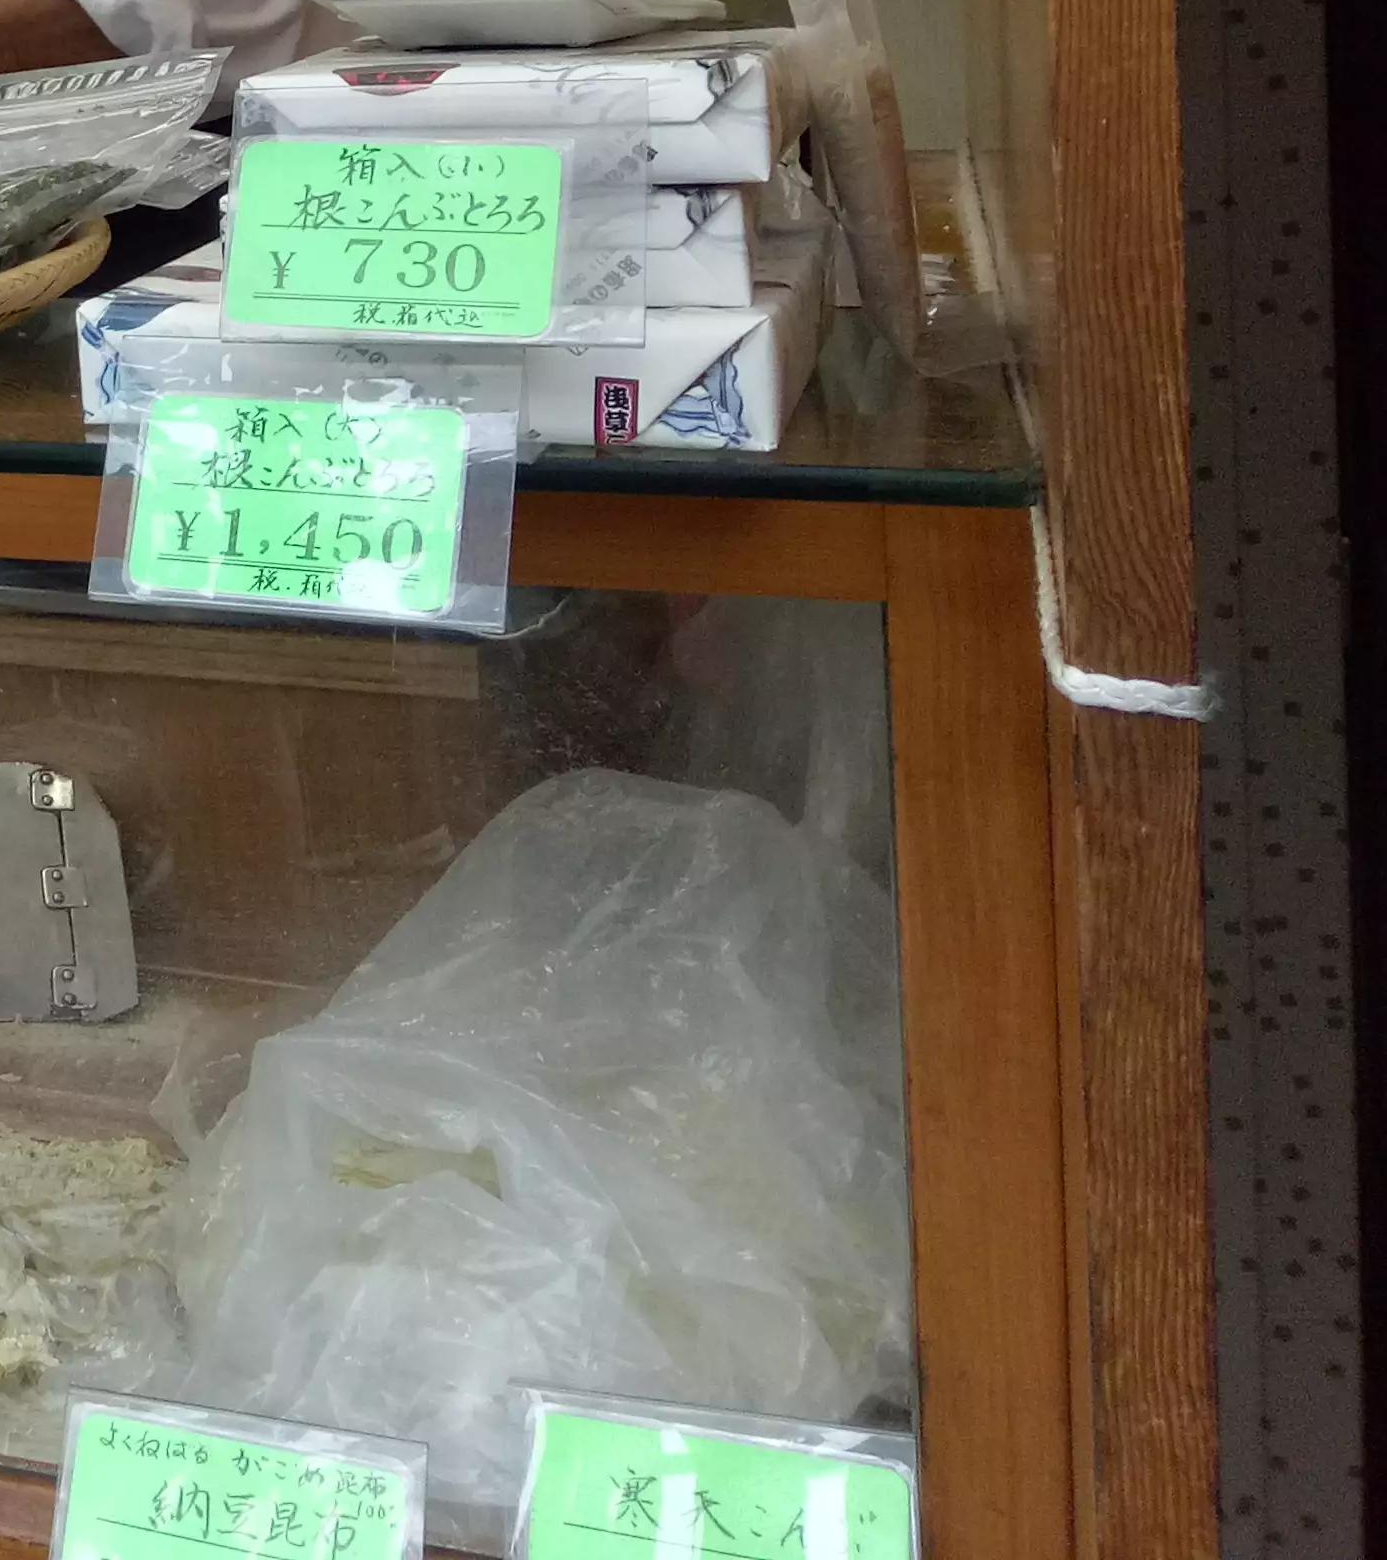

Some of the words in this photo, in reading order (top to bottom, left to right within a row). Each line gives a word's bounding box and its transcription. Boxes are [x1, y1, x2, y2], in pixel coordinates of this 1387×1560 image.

[287, 184, 546, 235] 根こんぶとろろ
[191, 448, 436, 498] 根こんぶとろろ
[147, 1479, 358, 1560] 納豆昆布
